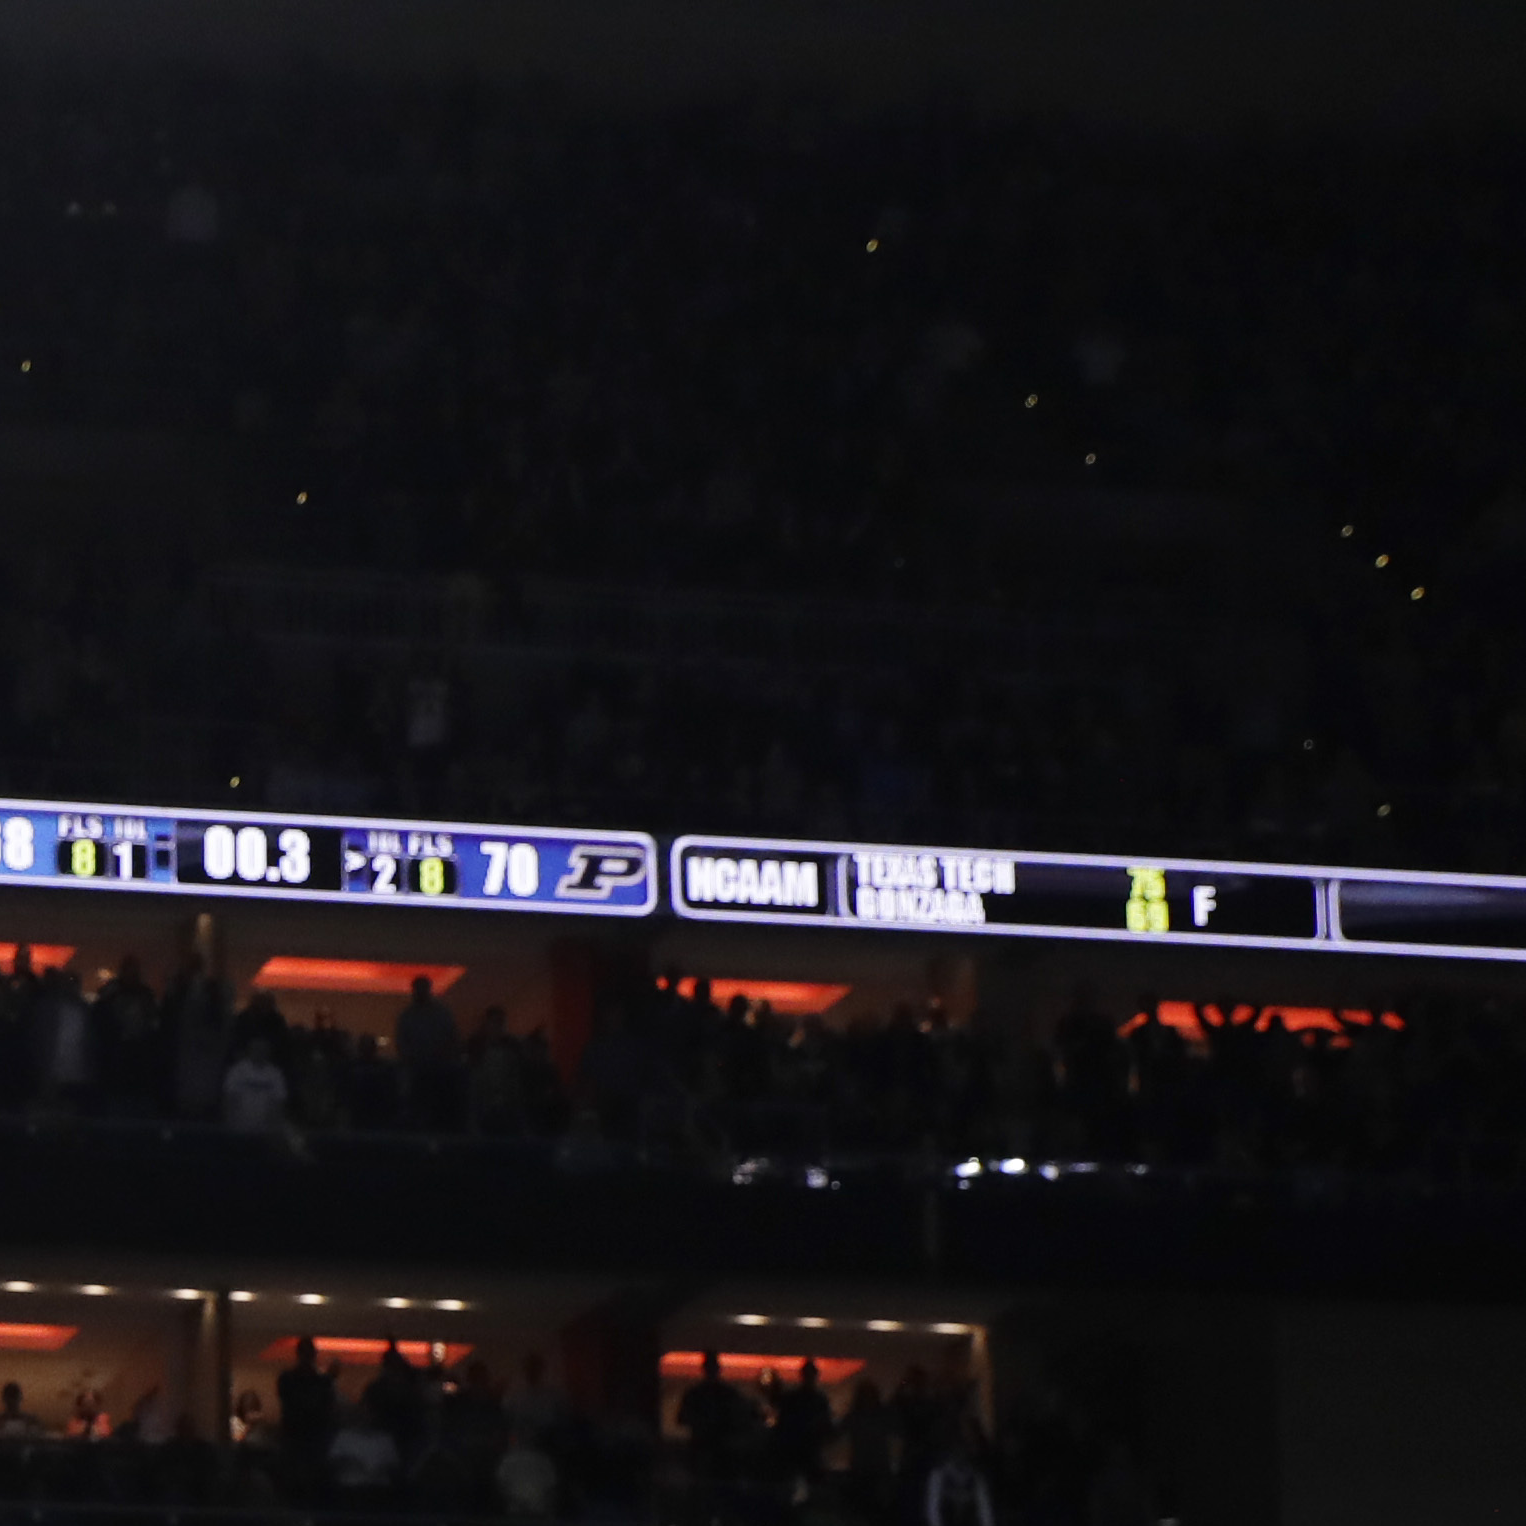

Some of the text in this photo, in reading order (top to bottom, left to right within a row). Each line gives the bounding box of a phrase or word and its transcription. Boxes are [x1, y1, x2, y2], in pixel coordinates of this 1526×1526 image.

[71, 837, 134, 881] 8 1
[203, 824, 311, 883] 00.3
[479, 840, 539, 897] 70
[554, 844, 647, 899] P
[371, 854, 446, 897] 2 8
[852, 852, 938, 889] TEXAS
[939, 856, 1016, 895] TECH
[686, 856, 819, 907] NCAAM
[1192, 885, 1218, 927] F
